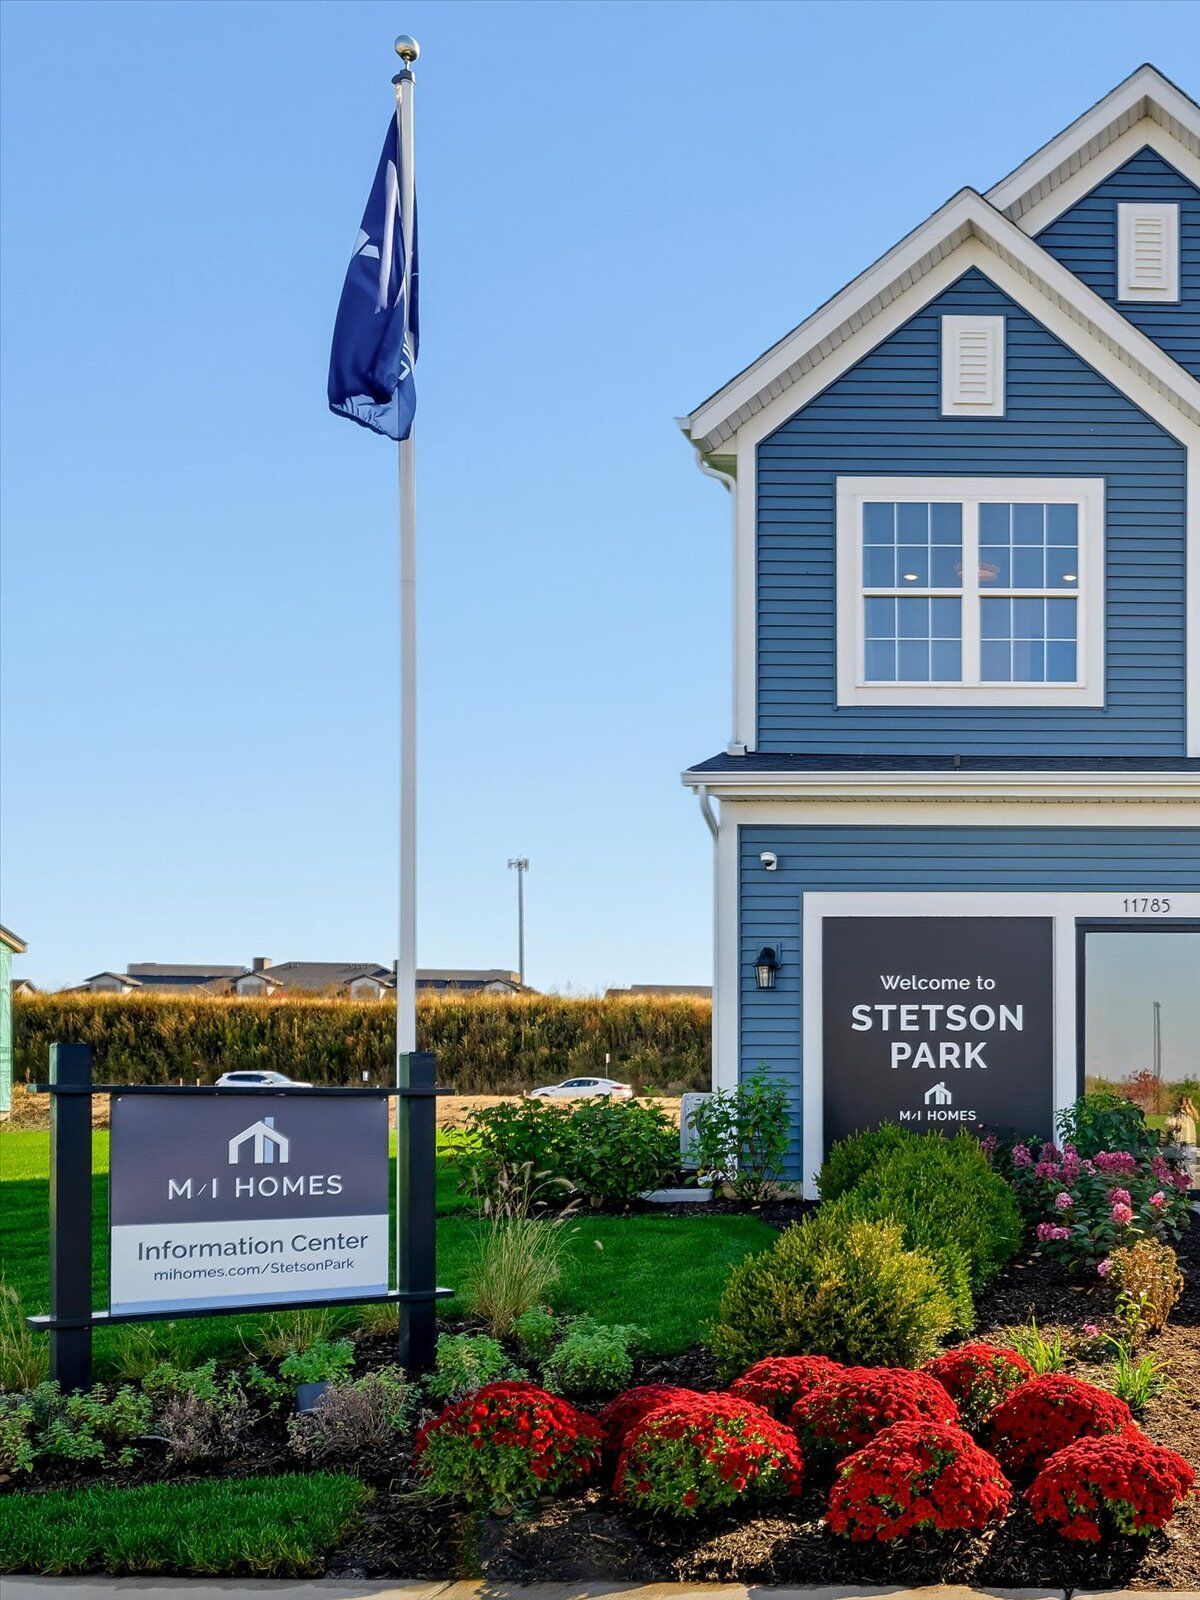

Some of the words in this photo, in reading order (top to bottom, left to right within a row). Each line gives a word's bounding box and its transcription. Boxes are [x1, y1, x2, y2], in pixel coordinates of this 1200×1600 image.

[1123, 898, 1170, 913] 11785
[880, 975, 970, 990] Welcome
[977, 975, 996, 990] to
[851, 1004, 1023, 1031] STETSON
[891, 1042, 988, 1069] PARK
[927, 1110, 977, 1121] HOMES
[168, 1177, 218, 1200] M/I
[235, 1174, 343, 1198] HOMES
[138, 1236, 284, 1261] Information
[291, 1233, 369, 1252] Center
[153, 1258, 355, 1281] mihomes.com/StetsonPark
